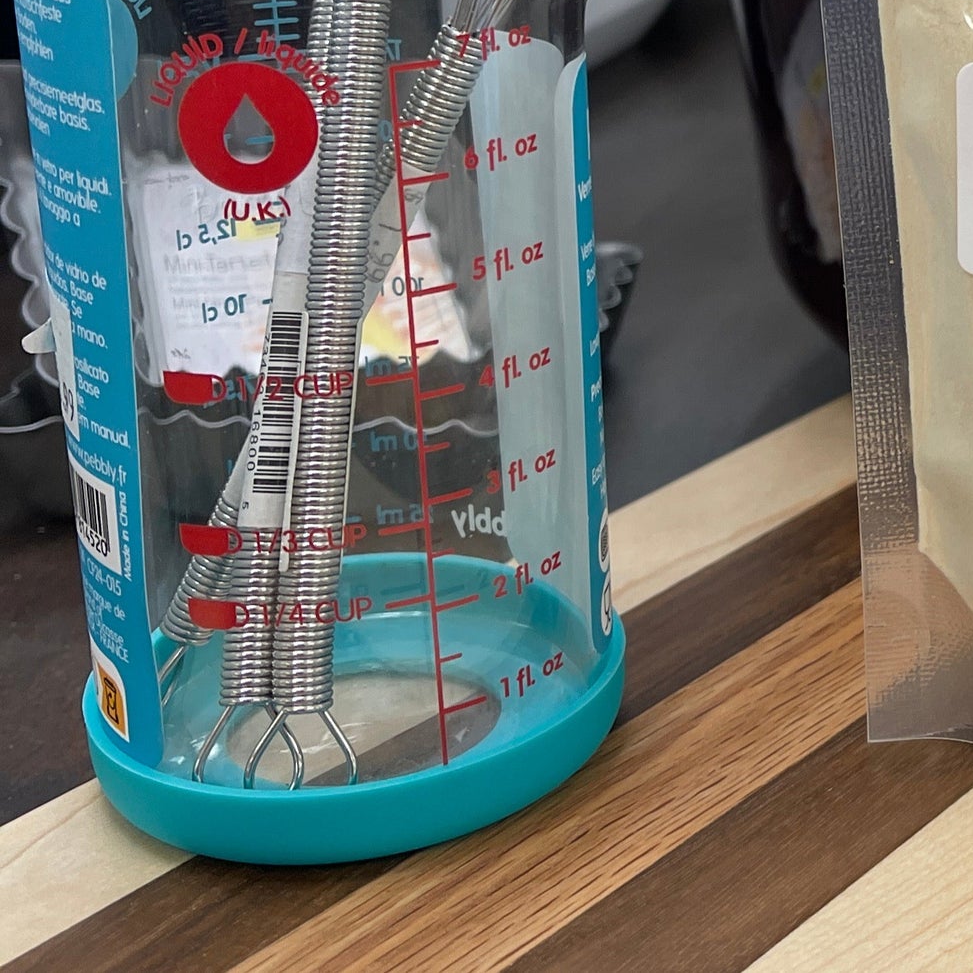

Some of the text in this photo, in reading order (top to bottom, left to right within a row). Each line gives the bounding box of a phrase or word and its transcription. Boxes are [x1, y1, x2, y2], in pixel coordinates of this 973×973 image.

[456, 25, 532, 60] 7 fl. oz
[150, 32, 224, 108] LIQUID
[257, 29, 342, 107] liquide
[59, 105, 91, 132] basis.
[464, 133, 538, 172] 6 fl. oz
[59, 167, 75, 186] per
[223, 196, 292, 222] (U.K.)
[473, 241, 544, 281] 5 fl. oz
[70, 280, 94, 306] Base
[91, 270, 107, 291] de
[71, 299, 83, 320] Se
[76, 324, 108, 350] mano.
[478, 347, 551, 389] 4 fl. oz
[77, 373, 100, 399] Base
[294, 371, 353, 399] CUP
[91, 420, 131, 449] manual.
[246, 409, 261, 472] 16800
[486, 448, 556, 494] 3 fl. oz
[242, 501, 250, 511] 5
[118, 490, 133, 583] Made in China
[252, 524, 367, 553] 1/3 CUP
[493, 551, 562, 599] 2 fl. oz
[261, 596, 372, 627] 1/4 CUP
[500, 651, 565, 699] 1 fl. oz
